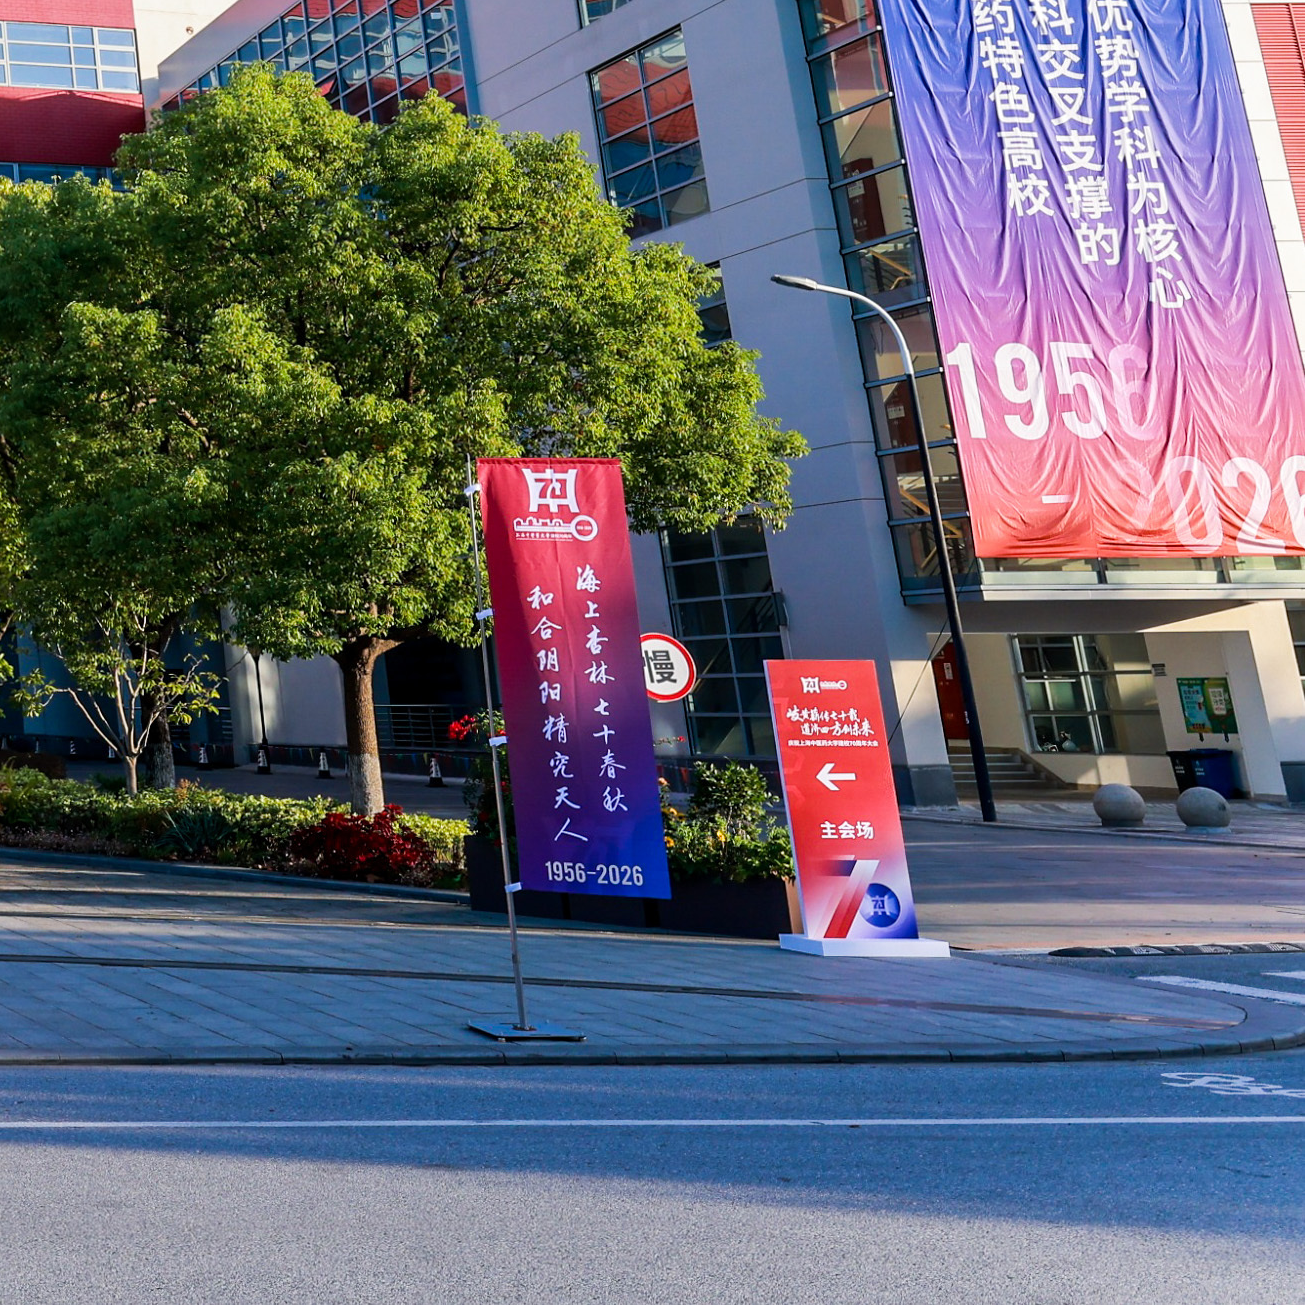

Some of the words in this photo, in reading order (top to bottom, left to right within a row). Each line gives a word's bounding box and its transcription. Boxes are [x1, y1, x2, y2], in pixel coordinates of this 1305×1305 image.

[947, 342, 1165, 440] 1956
[643, 650, 677, 683] 慢
[576, 564, 628, 813] 海上杏林七十春秋
[821, 821, 874, 840] 主会场
[545, 861, 643, 886] 1956-2026
